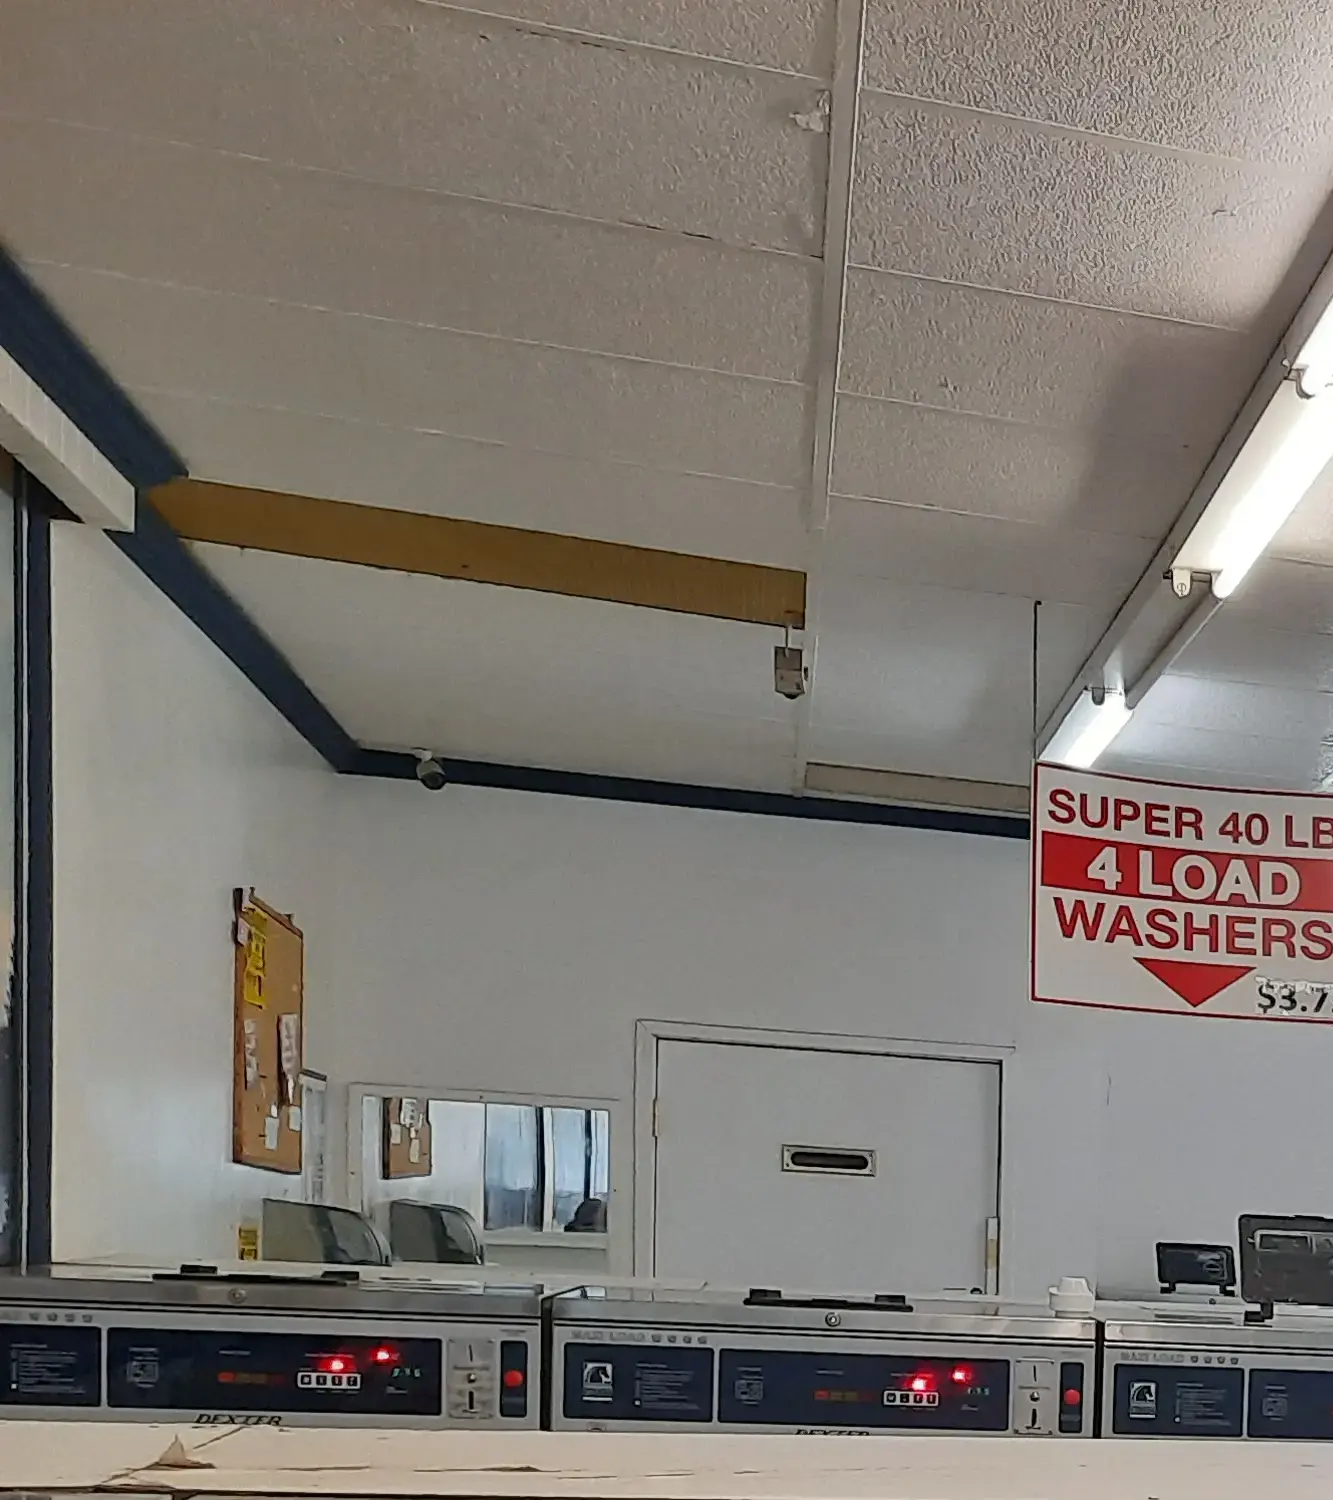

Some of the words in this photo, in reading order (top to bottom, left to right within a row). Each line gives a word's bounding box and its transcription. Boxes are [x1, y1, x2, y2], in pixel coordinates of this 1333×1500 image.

[1048, 788, 1203, 841] SUPER
[1218, 812, 1269, 846] 40
[1087, 846, 1122, 891] 4
[1139, 850, 1300, 906] LOAD
[1053, 897, 1333, 960] WASHERS
[195, 1413, 282, 1426] DEXTER
